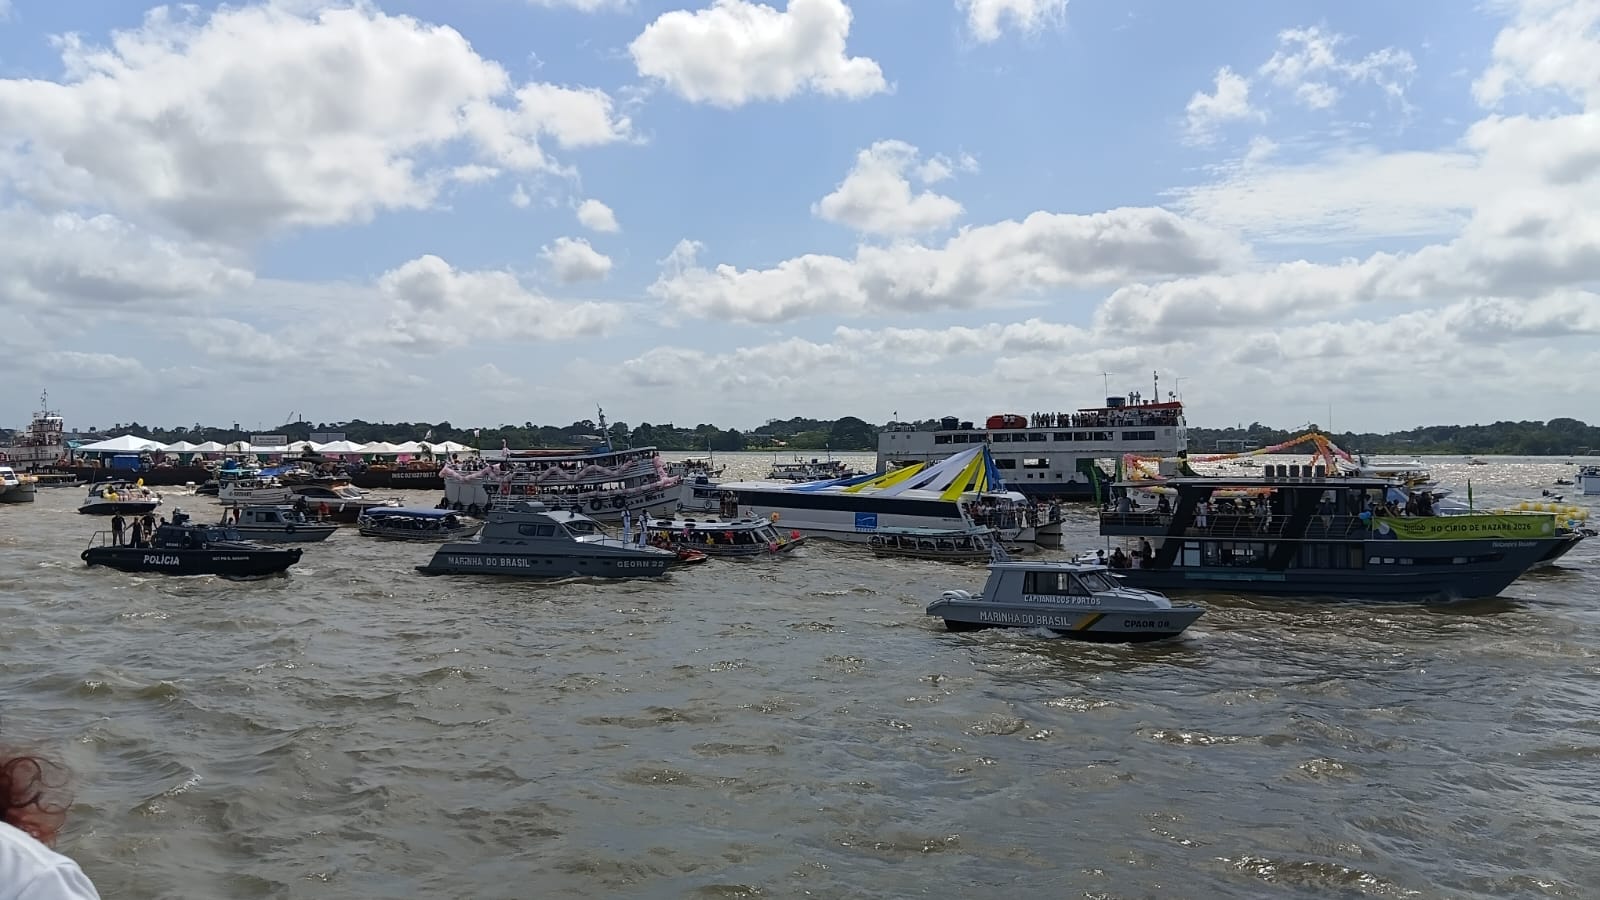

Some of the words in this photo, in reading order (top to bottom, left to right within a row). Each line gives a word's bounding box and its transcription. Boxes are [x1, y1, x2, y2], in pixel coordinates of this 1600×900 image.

[143, 554, 180, 565] POLÍCIA
[448, 556, 483, 566] MARINHA
[486, 558, 497, 566] DO
[500, 558, 530, 567] BRASIL
[1071, 597, 1101, 605] PORTOS
[980, 611, 1020, 623] MARINHA
[1022, 614, 1034, 624] DO
[1036, 615, 1071, 626] BRASIL
